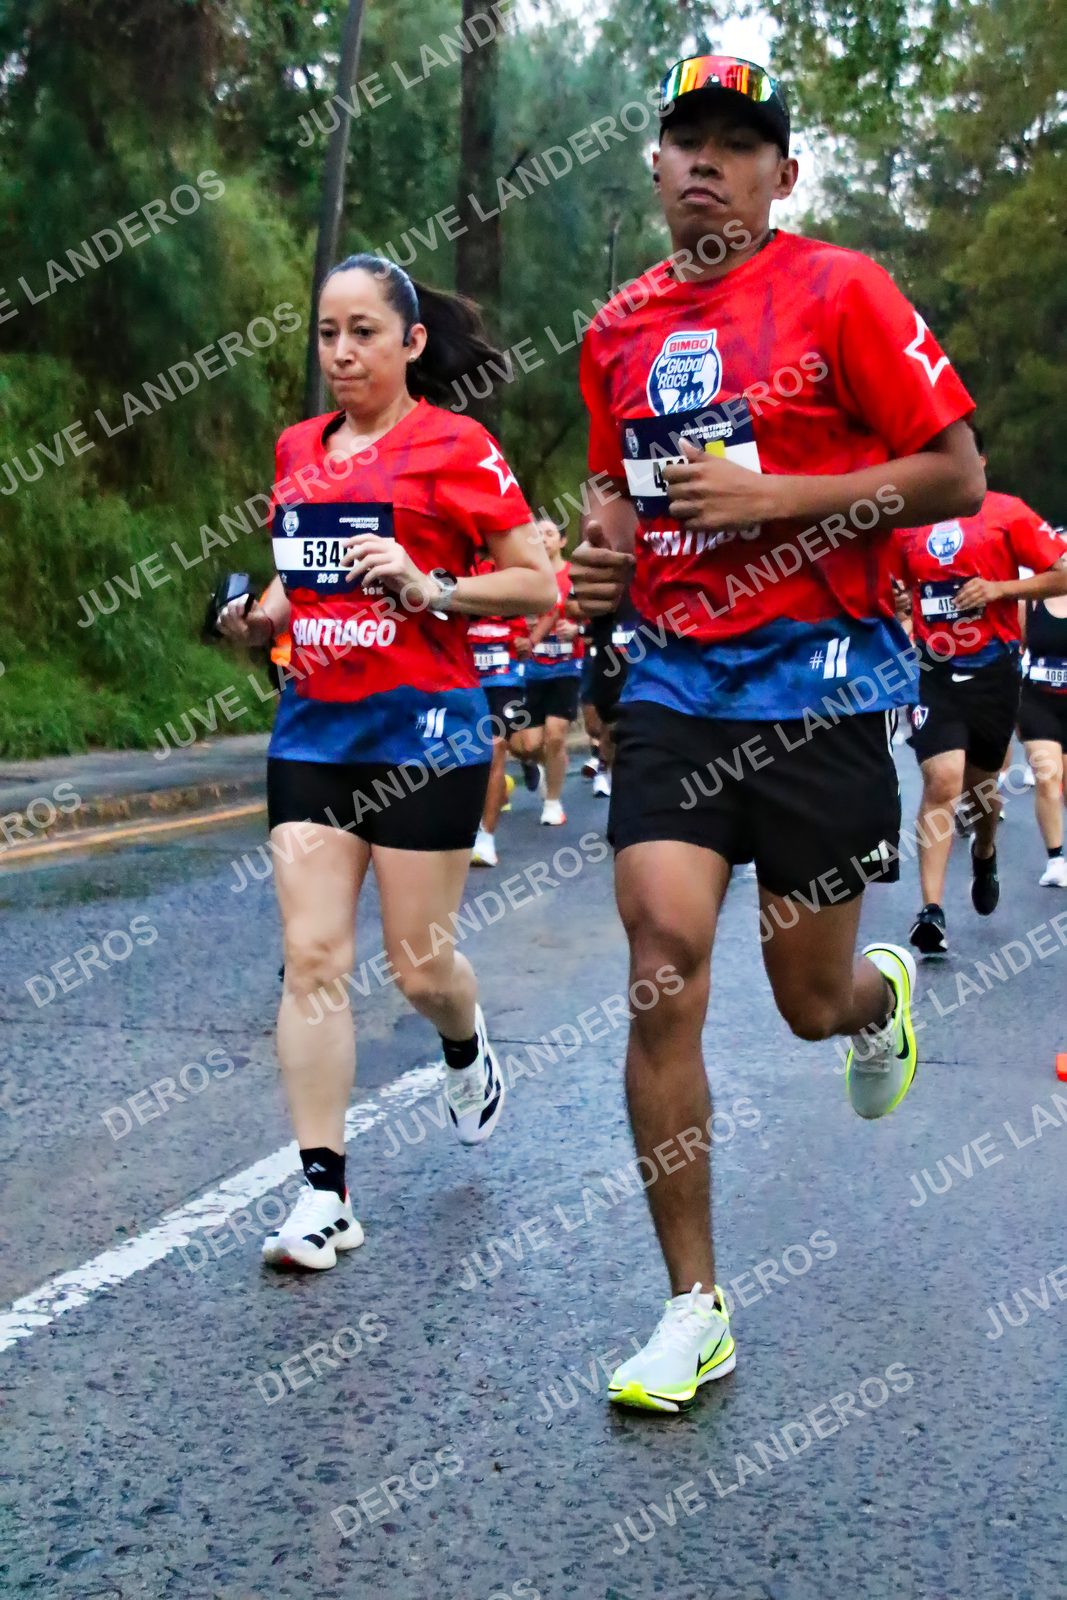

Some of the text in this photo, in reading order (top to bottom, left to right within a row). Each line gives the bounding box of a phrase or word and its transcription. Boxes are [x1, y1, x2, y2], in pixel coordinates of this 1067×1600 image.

[669, 339, 708, 353] BIMBO
[666, 356, 705, 374] Global
[657, 373, 689, 390] Race
[293, 617, 397, 648] SANTIAGO
